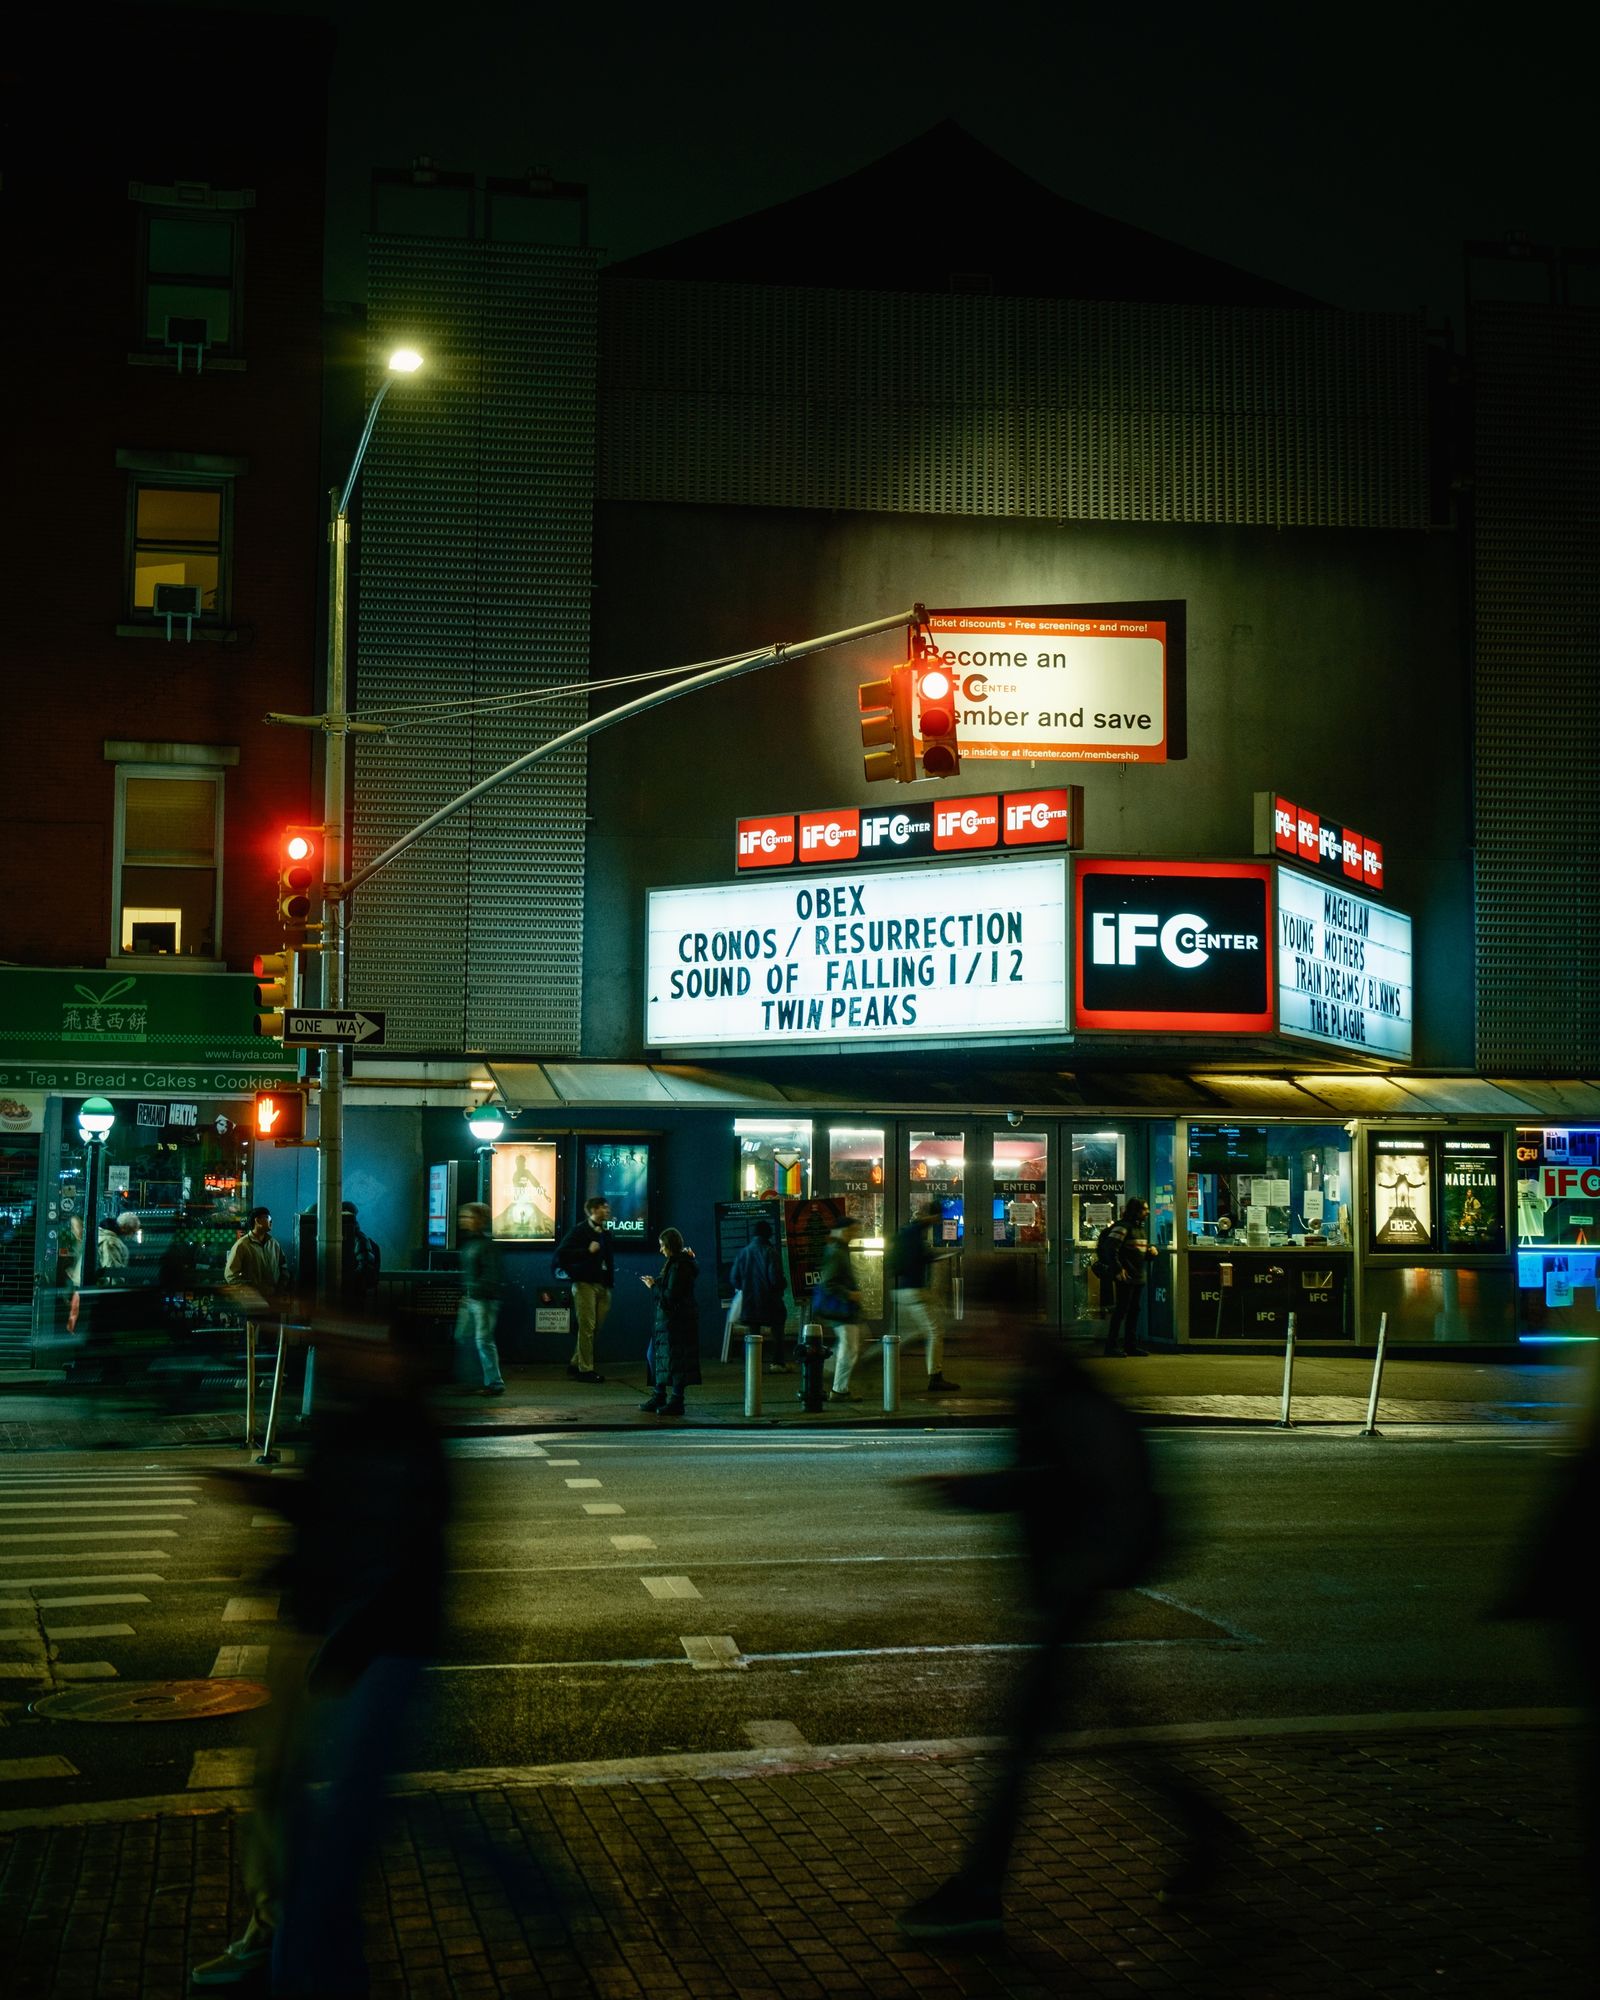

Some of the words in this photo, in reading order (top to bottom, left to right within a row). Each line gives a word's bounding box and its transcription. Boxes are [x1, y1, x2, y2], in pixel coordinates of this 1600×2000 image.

[929, 618, 957, 627] Ticket
[959, 619, 1006, 629] discounts
[1015, 620, 1037, 629] Free
[1039, 621, 1091, 632] screenings
[1099, 623, 1118, 632] and
[1120, 624, 1148, 633] more!
[1037, 653, 1066, 668] an
[973, 684, 1017, 693] CENTER
[1038, 708, 1083, 728] and
[1093, 712, 1152, 729] save
[971, 748, 998, 757] inside
[1012, 749, 1021, 757] at
[1022, 748, 1140, 760] ifccenter.com/membership
[796, 885, 866, 920] OBEX
[1324, 892, 1369, 938] MAGELLAN
[679, 929, 777, 963] CRONOS
[815, 911, 1023, 956] RESURRECTION
[1181, 933, 1259, 950] CENTER
[1282, 913, 1314, 954] YOUNG
[1324, 929, 1364, 971] MOTHERS
[671, 966, 751, 1000] SOUND
[767, 963, 799, 994] OF
[827, 954, 935, 992] FALLING
[1295, 956, 1321, 994] TRAIN
[761, 999, 823, 1031] TWIN
[831, 994, 917, 1029] PEAKS
[1310, 998, 1329, 1034] THE
[1331, 1004, 1365, 1042] PLAGUE
[63, 1009, 148, 1034] 飛達西餅
[295, 1019, 322, 1033] ONE
[336, 1021, 365, 1034] WAY
[205, 1049, 284, 1061] www.fayda.com
[27, 1071, 57, 1085] Tea
[75, 1071, 126, 1087] Bread
[143, 1072, 197, 1088] Cakes
[1003, 1183, 1037, 1191] ENTER
[1445, 1173, 1497, 1187] MAGELLAN
[606, 1220, 645, 1231] PLAGUE
[1390, 1220, 1418, 1232] OBEX
